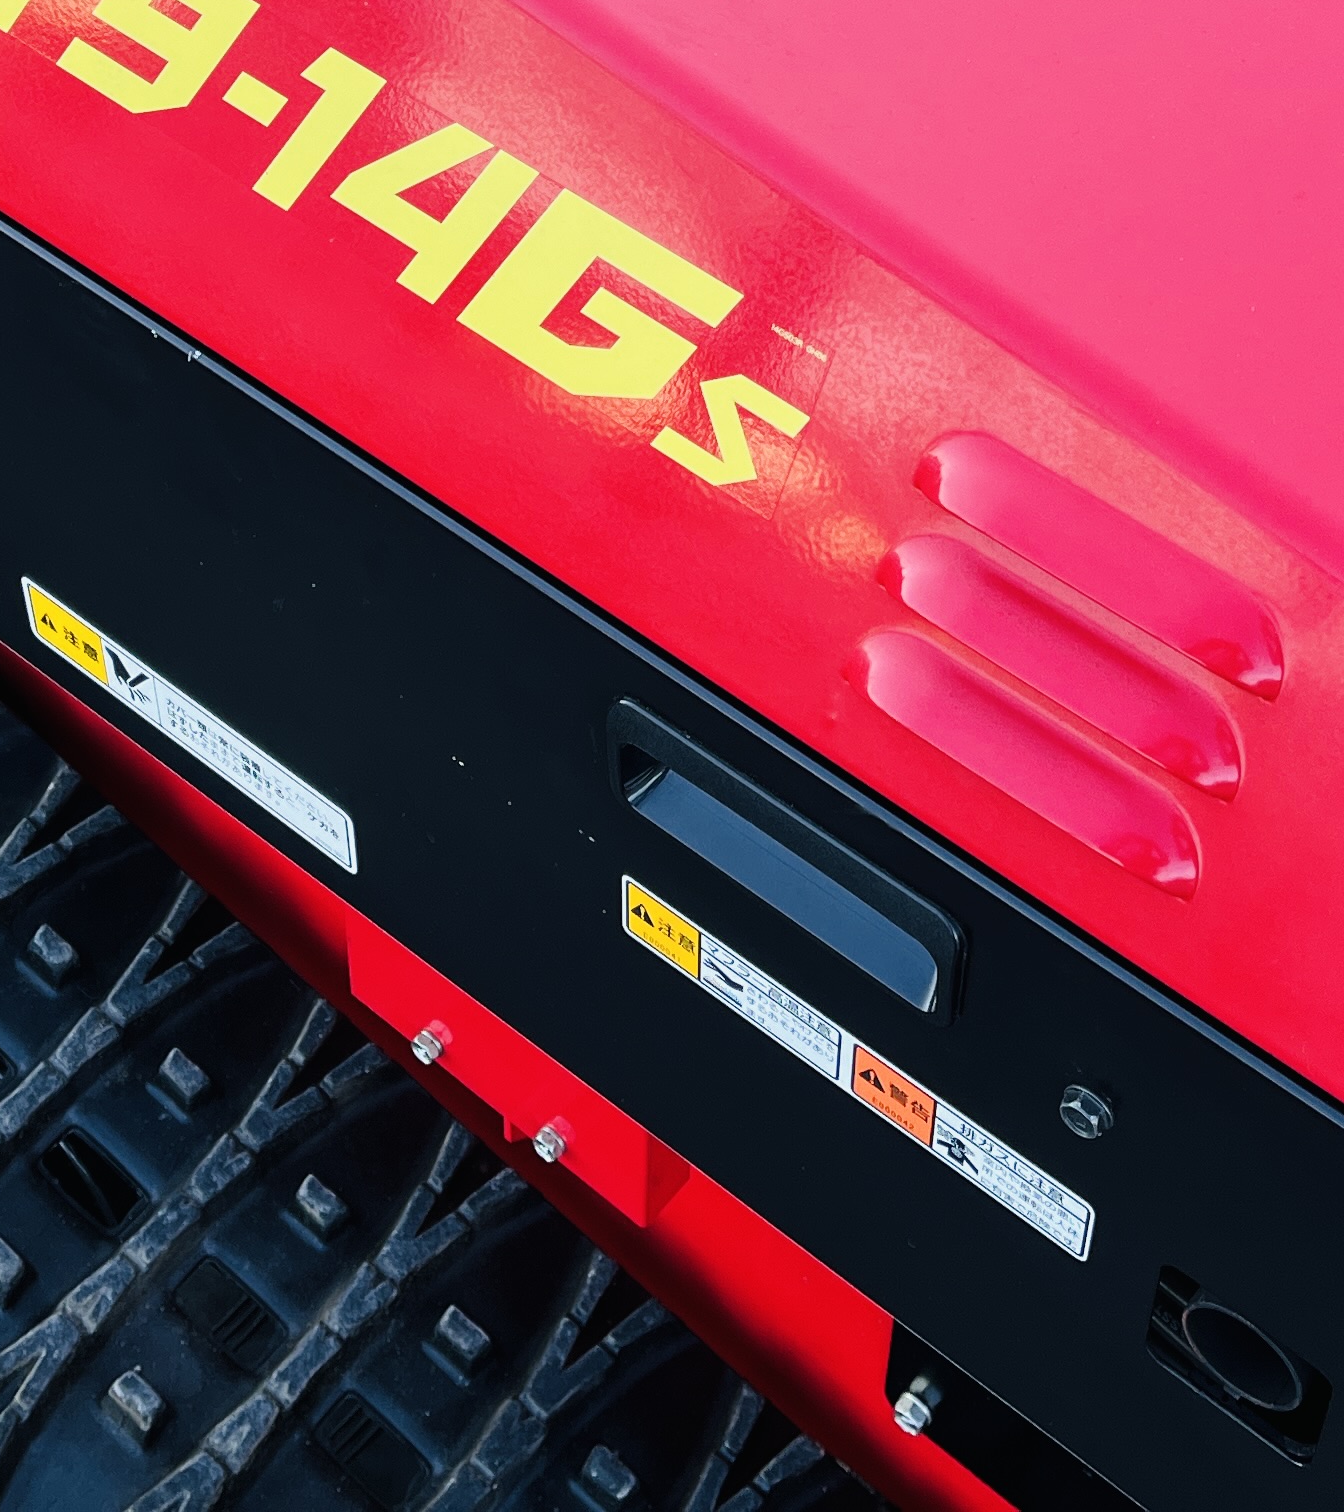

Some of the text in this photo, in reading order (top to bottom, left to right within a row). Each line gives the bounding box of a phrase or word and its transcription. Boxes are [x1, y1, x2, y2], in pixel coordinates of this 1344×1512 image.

[63, 626, 99, 664] 注意
[658, 917, 696, 956] 注意
[890, 1083, 930, 1123] 警告
